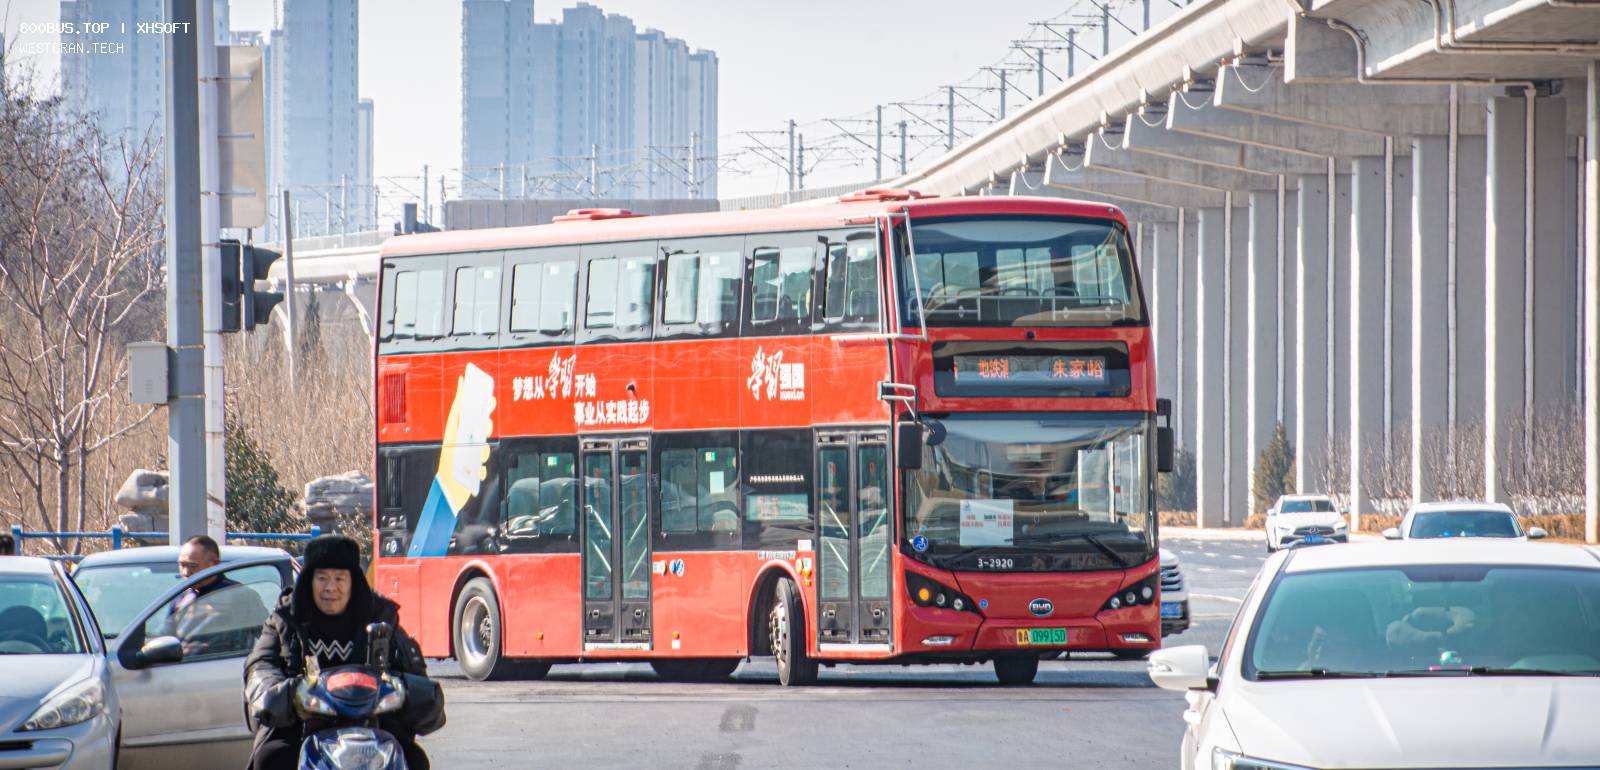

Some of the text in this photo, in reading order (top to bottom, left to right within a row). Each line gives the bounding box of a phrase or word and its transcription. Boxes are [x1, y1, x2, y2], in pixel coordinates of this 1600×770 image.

[1052, 359, 1103, 379] 朱家峪
[574, 399, 650, 426] 事业从实践起步
[977, 558, 1013, 569] 3-2920
[1032, 603, 1052, 611] BYD
